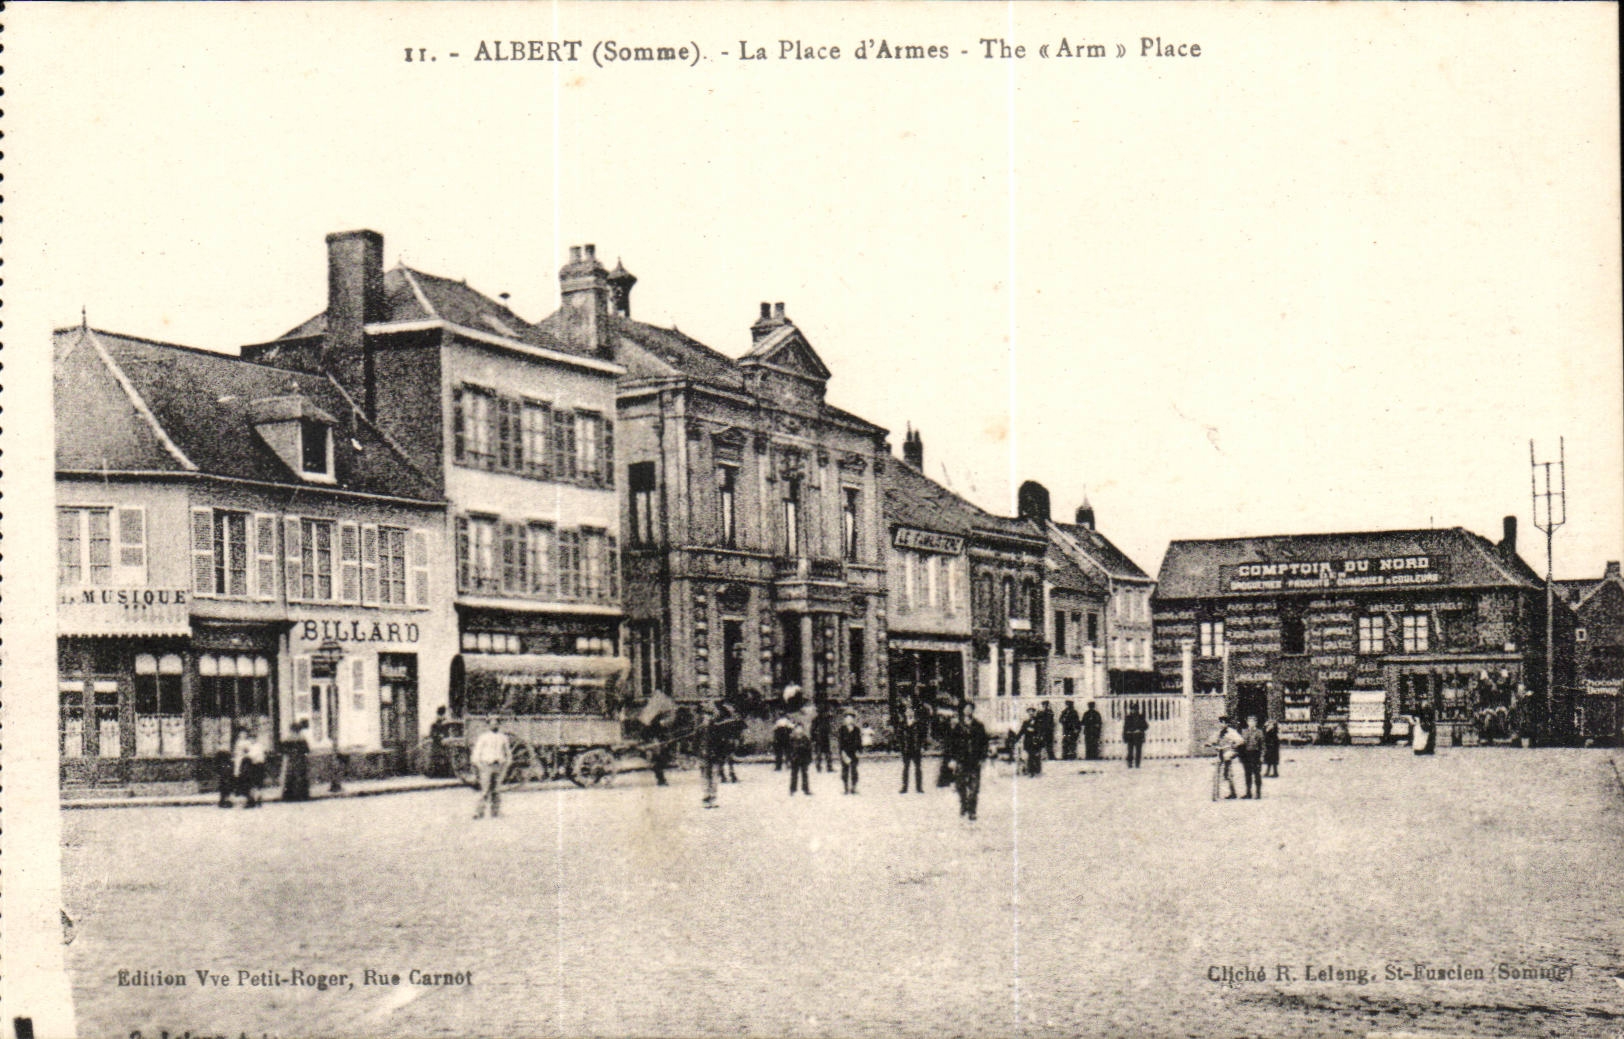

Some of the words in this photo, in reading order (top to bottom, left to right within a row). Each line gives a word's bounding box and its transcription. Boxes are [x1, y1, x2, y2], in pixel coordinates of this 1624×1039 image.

[1239, 562, 1331, 577] COMPTOIR
[1344, 560, 1369, 573] DU
[1381, 557, 1429, 571] NORD
[82, 589, 187, 606] MUSIQUE
[300, 619, 420, 643] BILLARD
